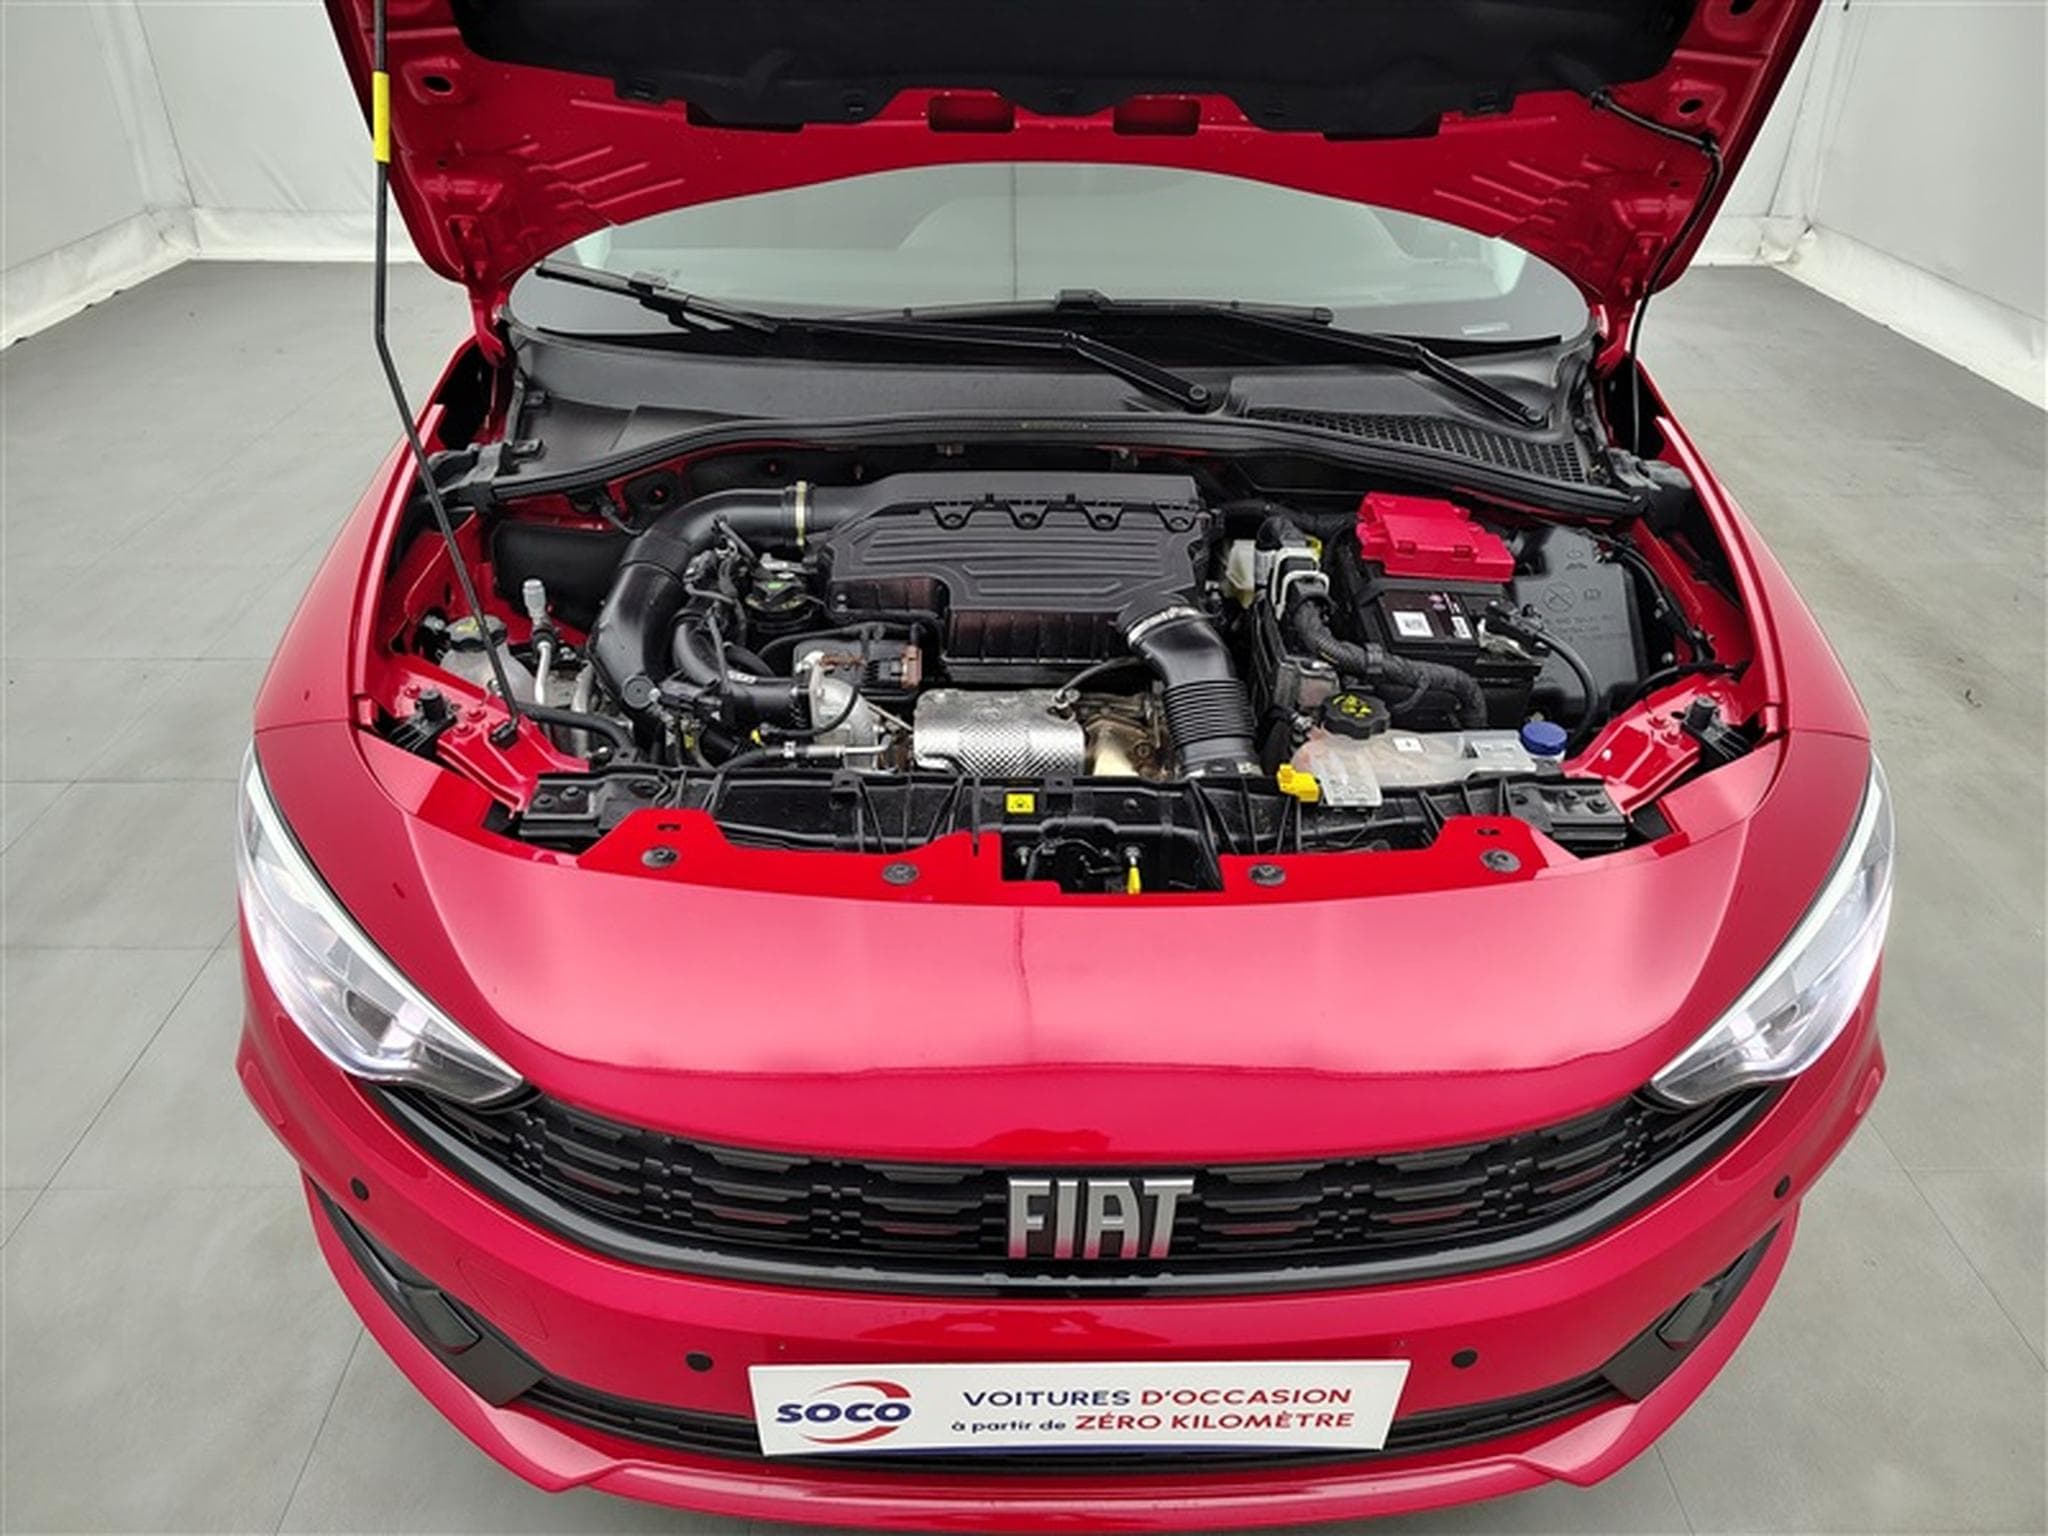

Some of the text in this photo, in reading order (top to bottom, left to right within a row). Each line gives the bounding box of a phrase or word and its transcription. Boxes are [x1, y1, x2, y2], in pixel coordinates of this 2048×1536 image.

[1007, 1178, 1195, 1259] FIAT
[963, 1388, 1352, 1407] VOITURES D'OCCASION
[775, 1402, 912, 1423] SOCO
[951, 1411, 1355, 1434] à partir de ZÉRO KILOMÈTRE
